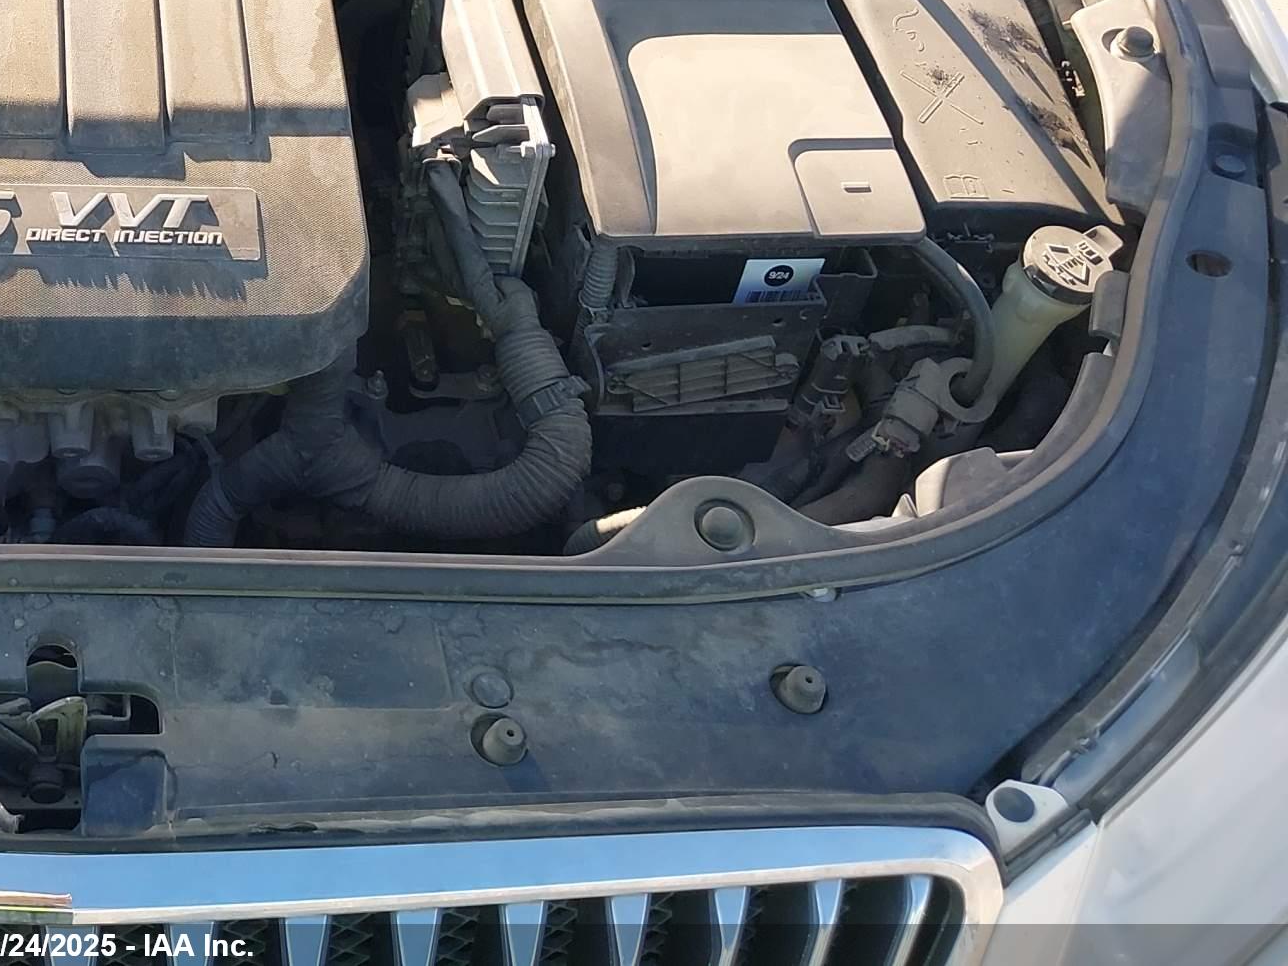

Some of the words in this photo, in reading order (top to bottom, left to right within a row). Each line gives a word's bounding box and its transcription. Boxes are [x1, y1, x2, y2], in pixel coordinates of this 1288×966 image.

[49, 191, 209, 229] VVT
[25, 228, 109, 244] DIRECT
[113, 229, 223, 246] INJECTION
